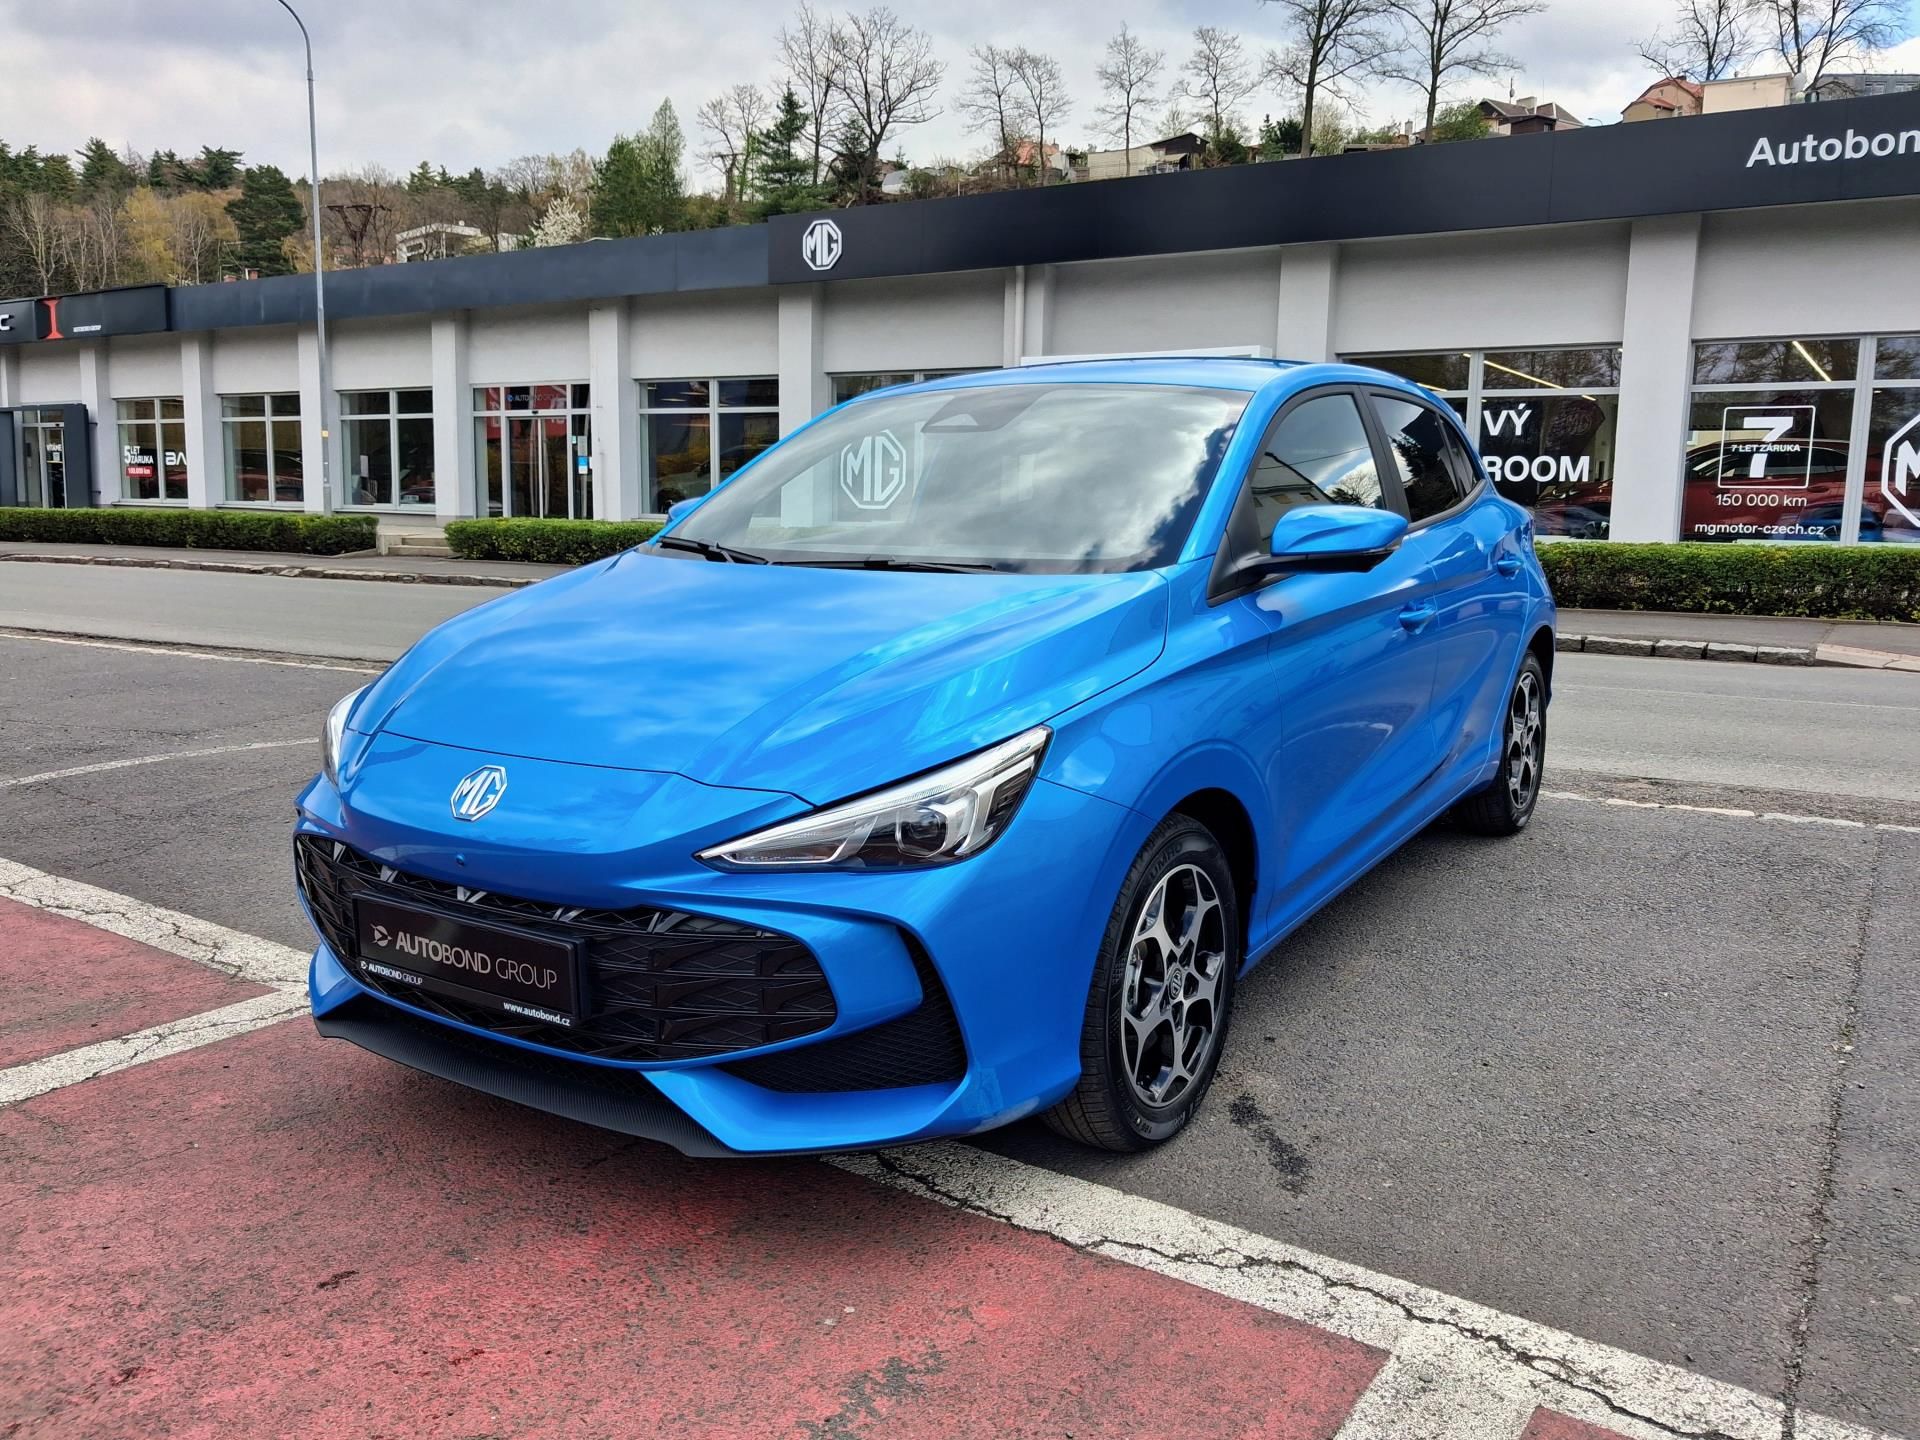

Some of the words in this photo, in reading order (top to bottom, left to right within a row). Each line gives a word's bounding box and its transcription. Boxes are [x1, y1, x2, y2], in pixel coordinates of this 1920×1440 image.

[1745, 128, 1920, 168] Autobon
[805, 224, 839, 267] MG
[1739, 444, 1758, 452] LET
[1759, 443, 1800, 452] ZÁRUKA
[845, 434, 901, 504] MG
[1481, 455, 1590, 482] ROOM
[1715, 494, 1742, 506] 150
[1746, 494, 1779, 507] 000
[1783, 494, 1807, 507] km
[1694, 523, 1825, 536] mgmotor-czech.cz
[453, 769, 504, 817] MG
[395, 931, 491, 974] AUTOBOND
[495, 958, 558, 990] GROUP
[368, 963, 402, 980] AUTOBOND
[402, 971, 423, 986] GROUP
[503, 1001, 571, 1027] www.autobond.cz
